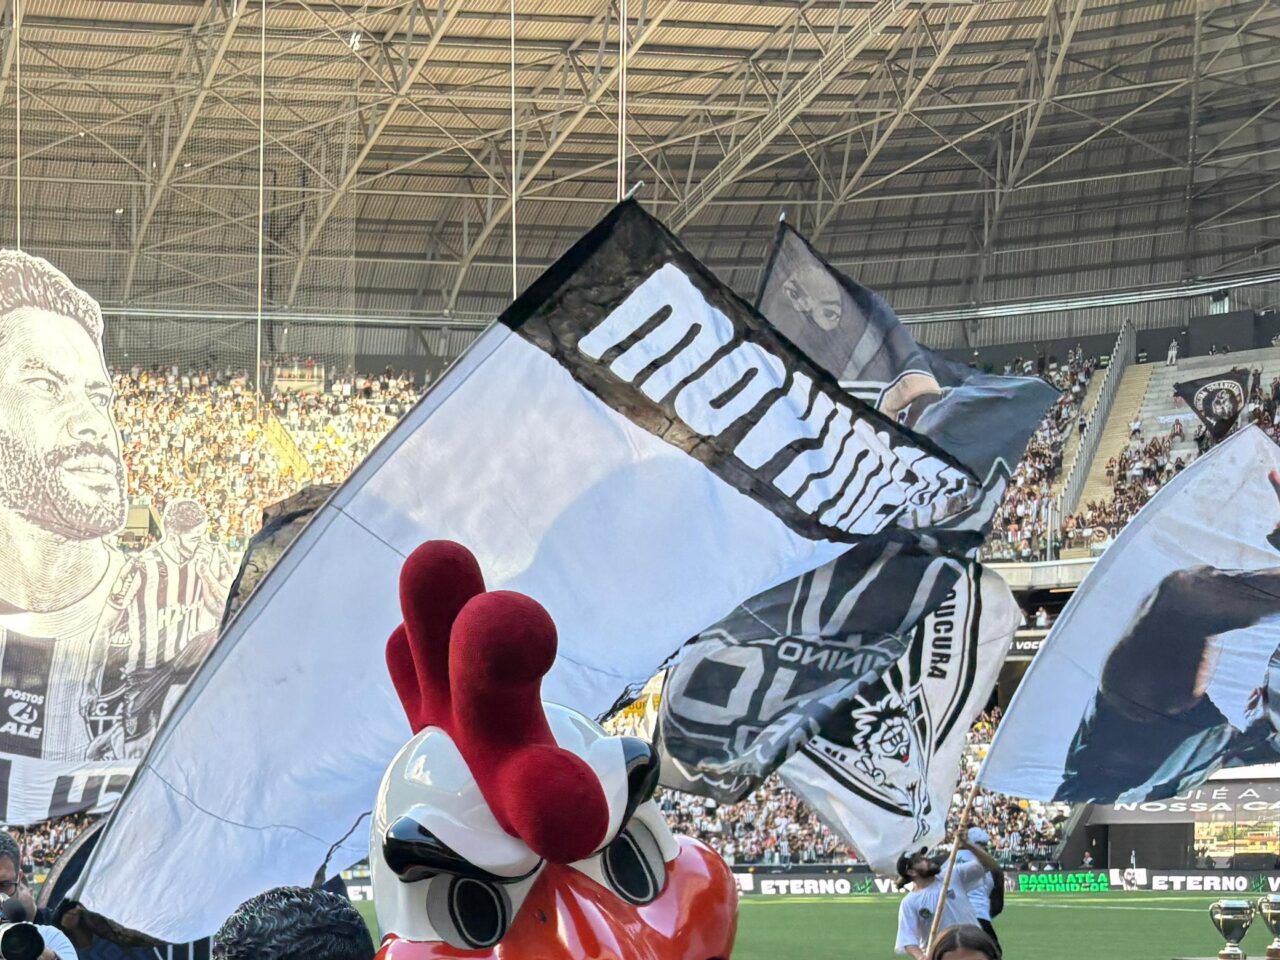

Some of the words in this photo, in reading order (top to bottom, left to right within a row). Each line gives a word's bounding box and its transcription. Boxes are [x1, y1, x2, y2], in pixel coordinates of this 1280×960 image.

[1016, 641, 1040, 650] VOC
[4, 688, 44, 704] POSTOS
[1238, 788, 1260, 799] A
[1114, 801, 1233, 812] NOSSA
[1019, 874, 1063, 884] DAQUI
[1066, 871, 1094, 884] ATÉ
[1097, 874, 1108, 884] A
[1152, 876, 1247, 891] ETERNO
[761, 879, 851, 894] ETERNO
